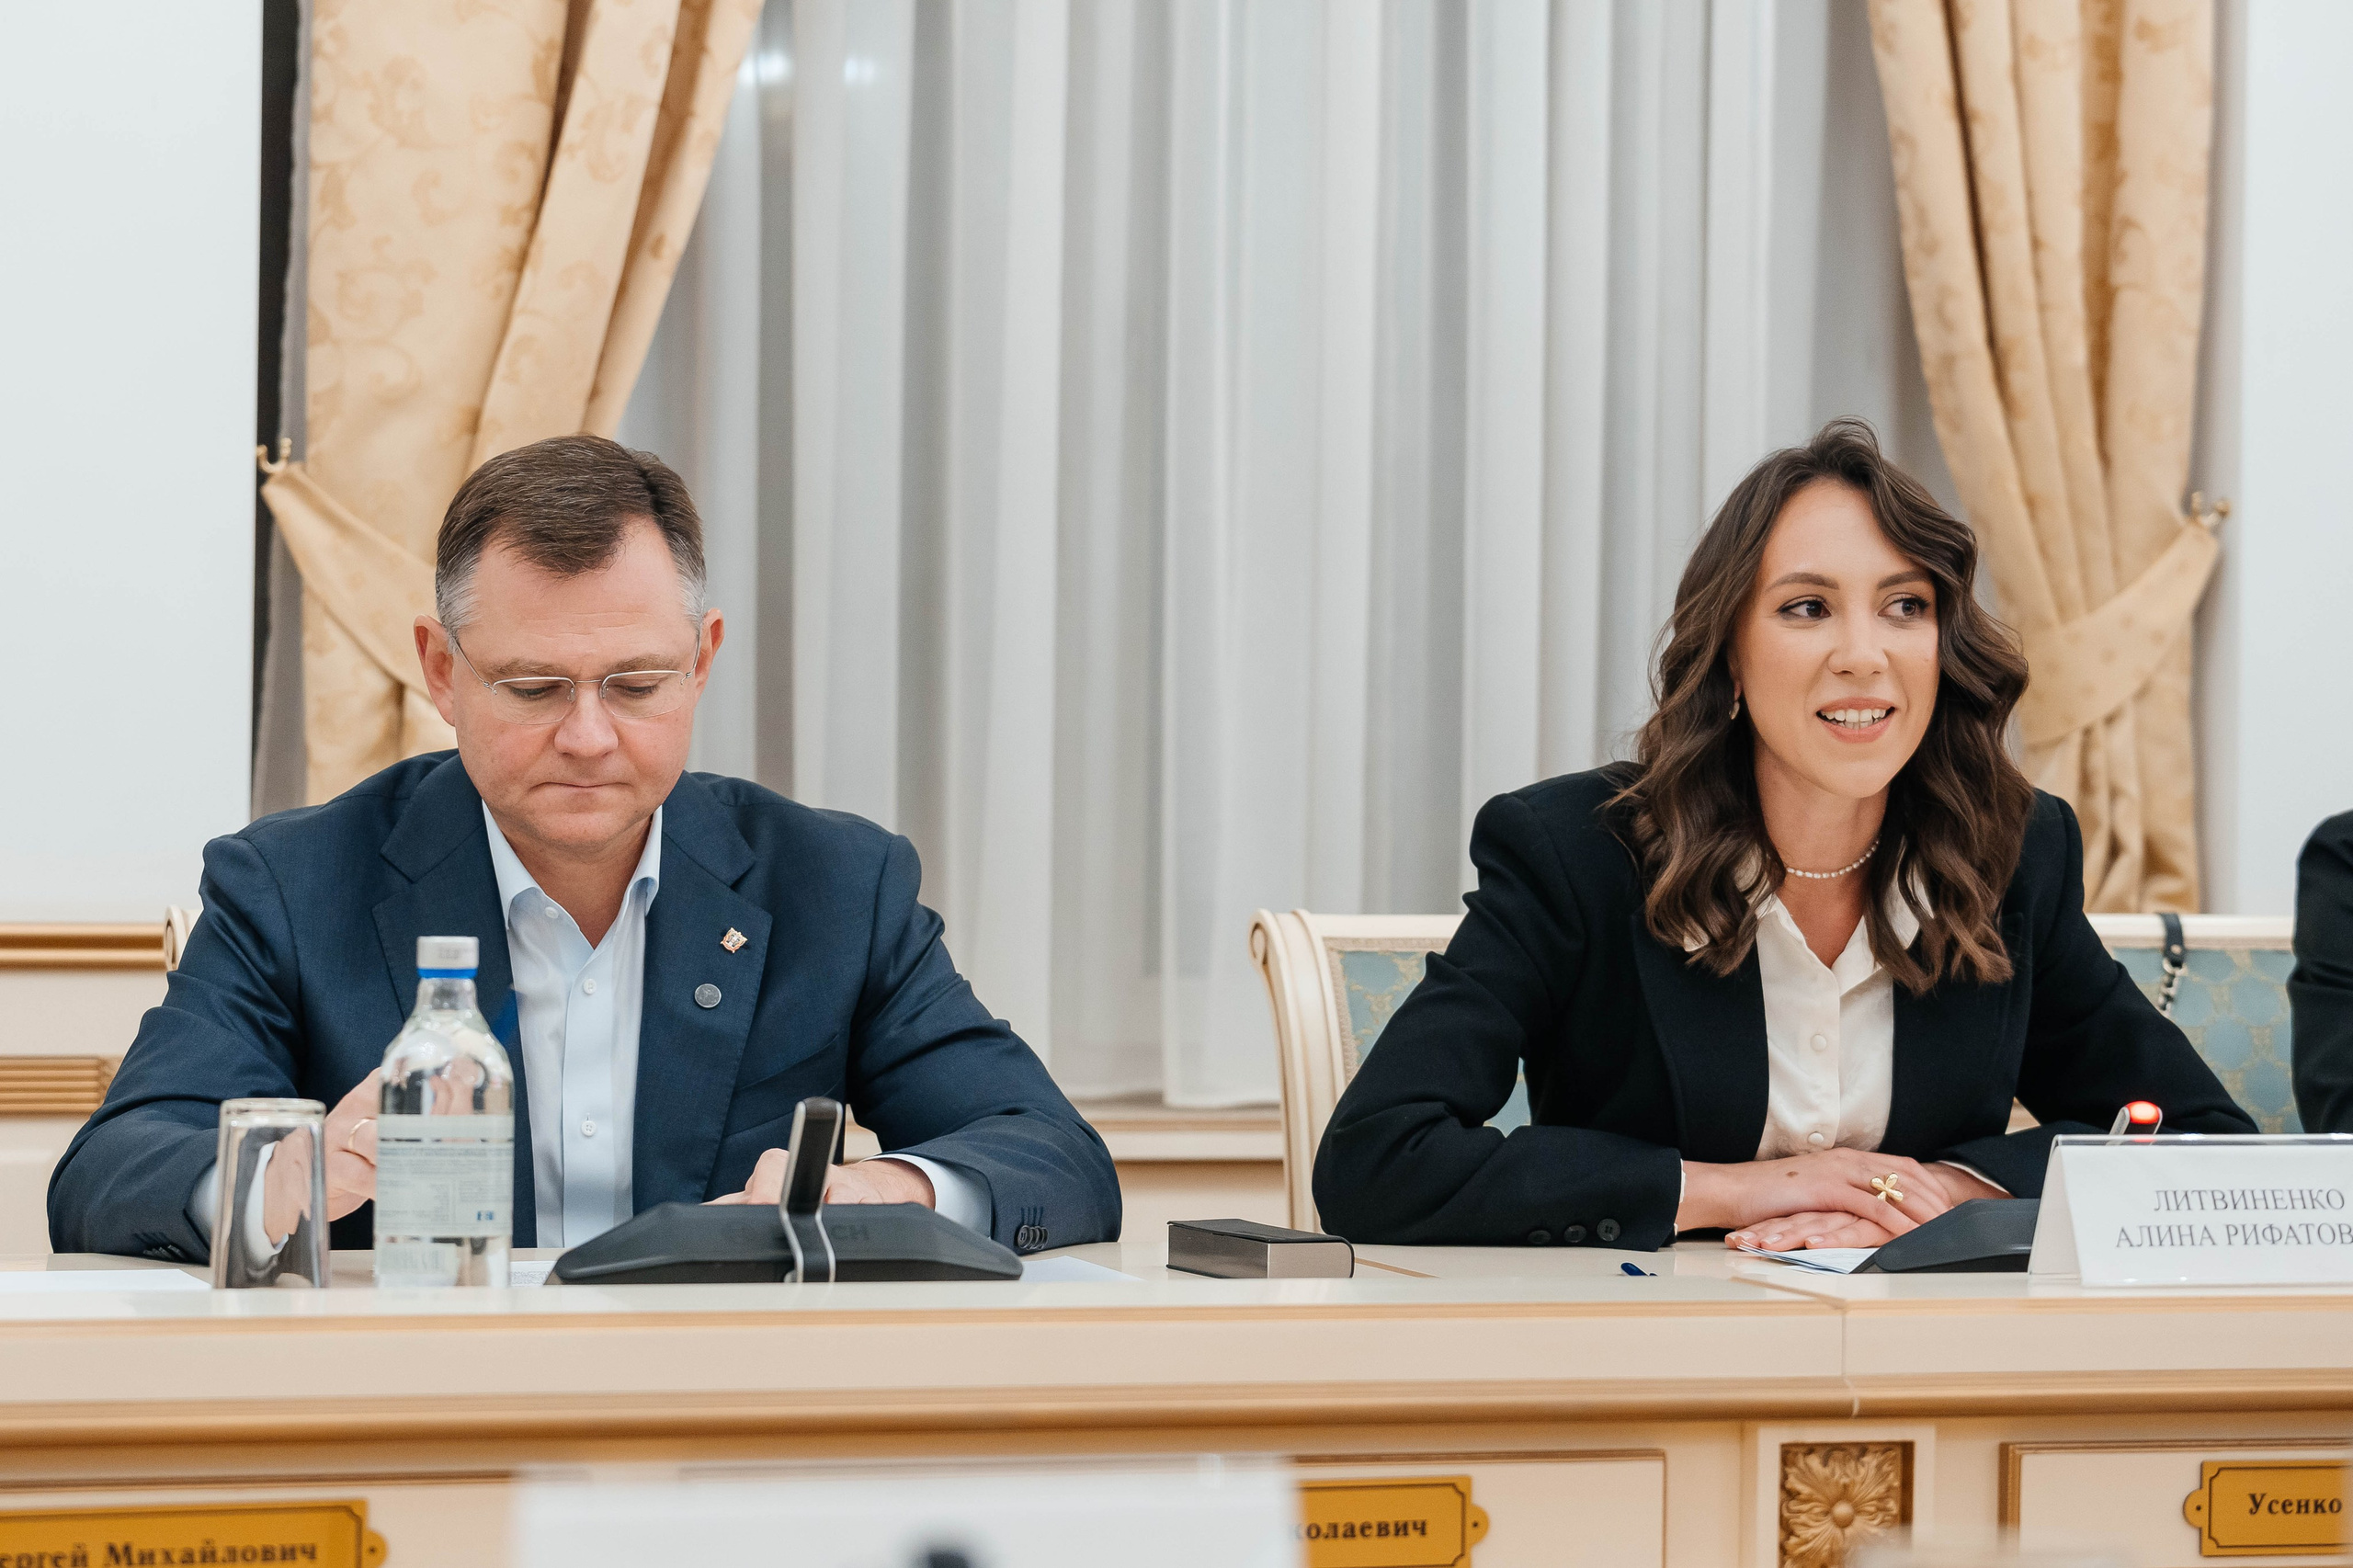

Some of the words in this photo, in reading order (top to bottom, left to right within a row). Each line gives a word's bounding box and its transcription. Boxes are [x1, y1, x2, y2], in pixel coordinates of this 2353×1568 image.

[2154, 1188, 2345, 1211] ЛИТВИНЕНКО
[2116, 1224, 2217, 1248] АЛИНА
[2223, 1222, 2353, 1246] РИФАТОВ
[2248, 1493, 2342, 1515] Усенко
[104, 1539, 318, 1567] Михайлович
